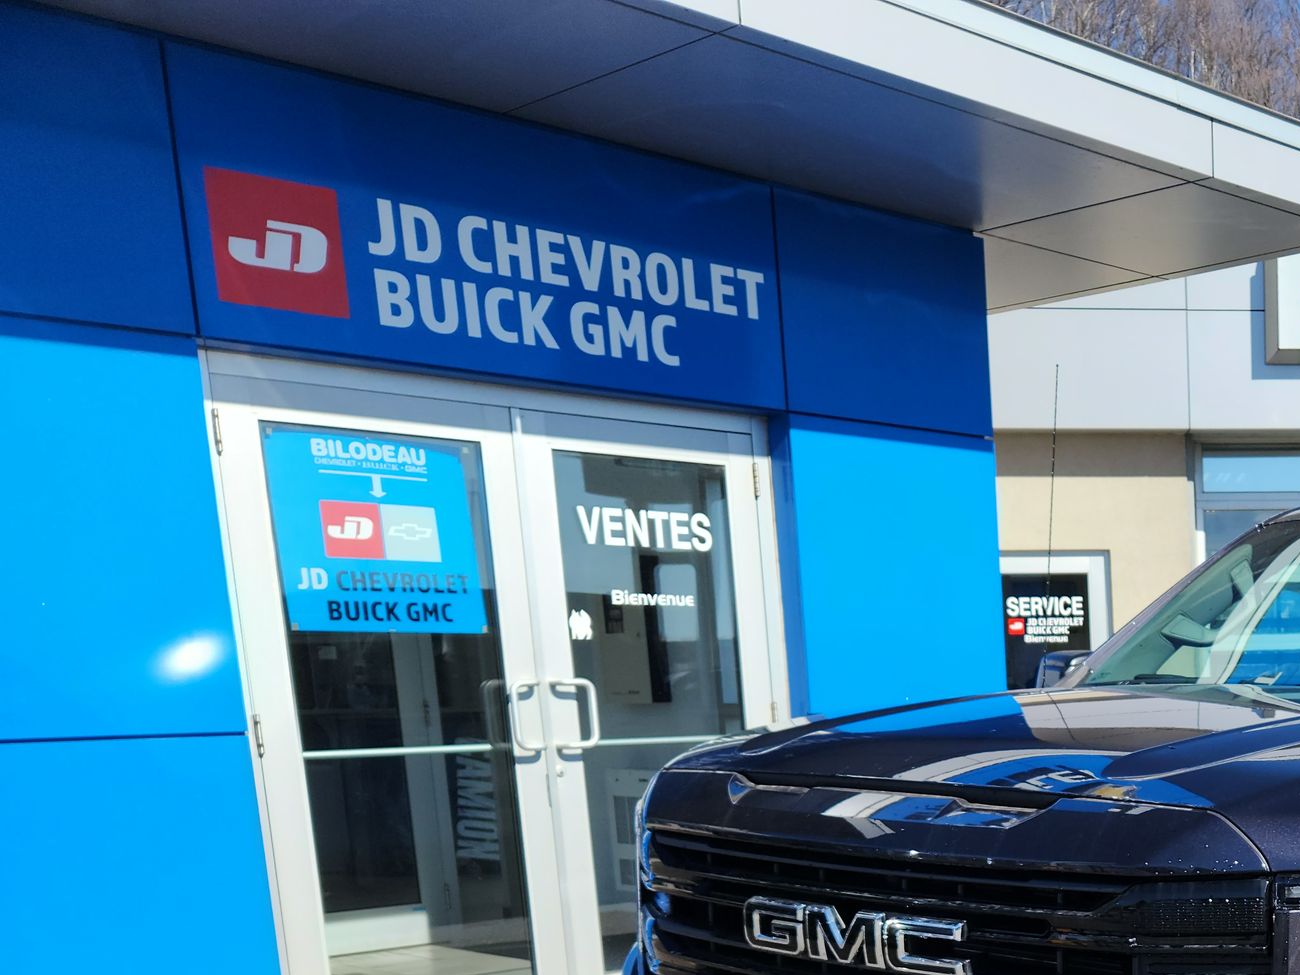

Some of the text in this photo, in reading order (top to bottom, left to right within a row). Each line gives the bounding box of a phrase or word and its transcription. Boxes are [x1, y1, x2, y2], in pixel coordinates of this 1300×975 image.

[368, 198, 764, 319] JD CHEVROLET
[374, 268, 681, 366] BUICK GMC
[310, 438, 426, 466] BILODEAU
[576, 505, 713, 552] VENTES
[298, 567, 468, 594] JD CHEVROLET
[327, 600, 454, 623] BUICK GMC
[611, 590, 695, 606] Bienvenue
[1006, 596, 1084, 616] SERVICE
